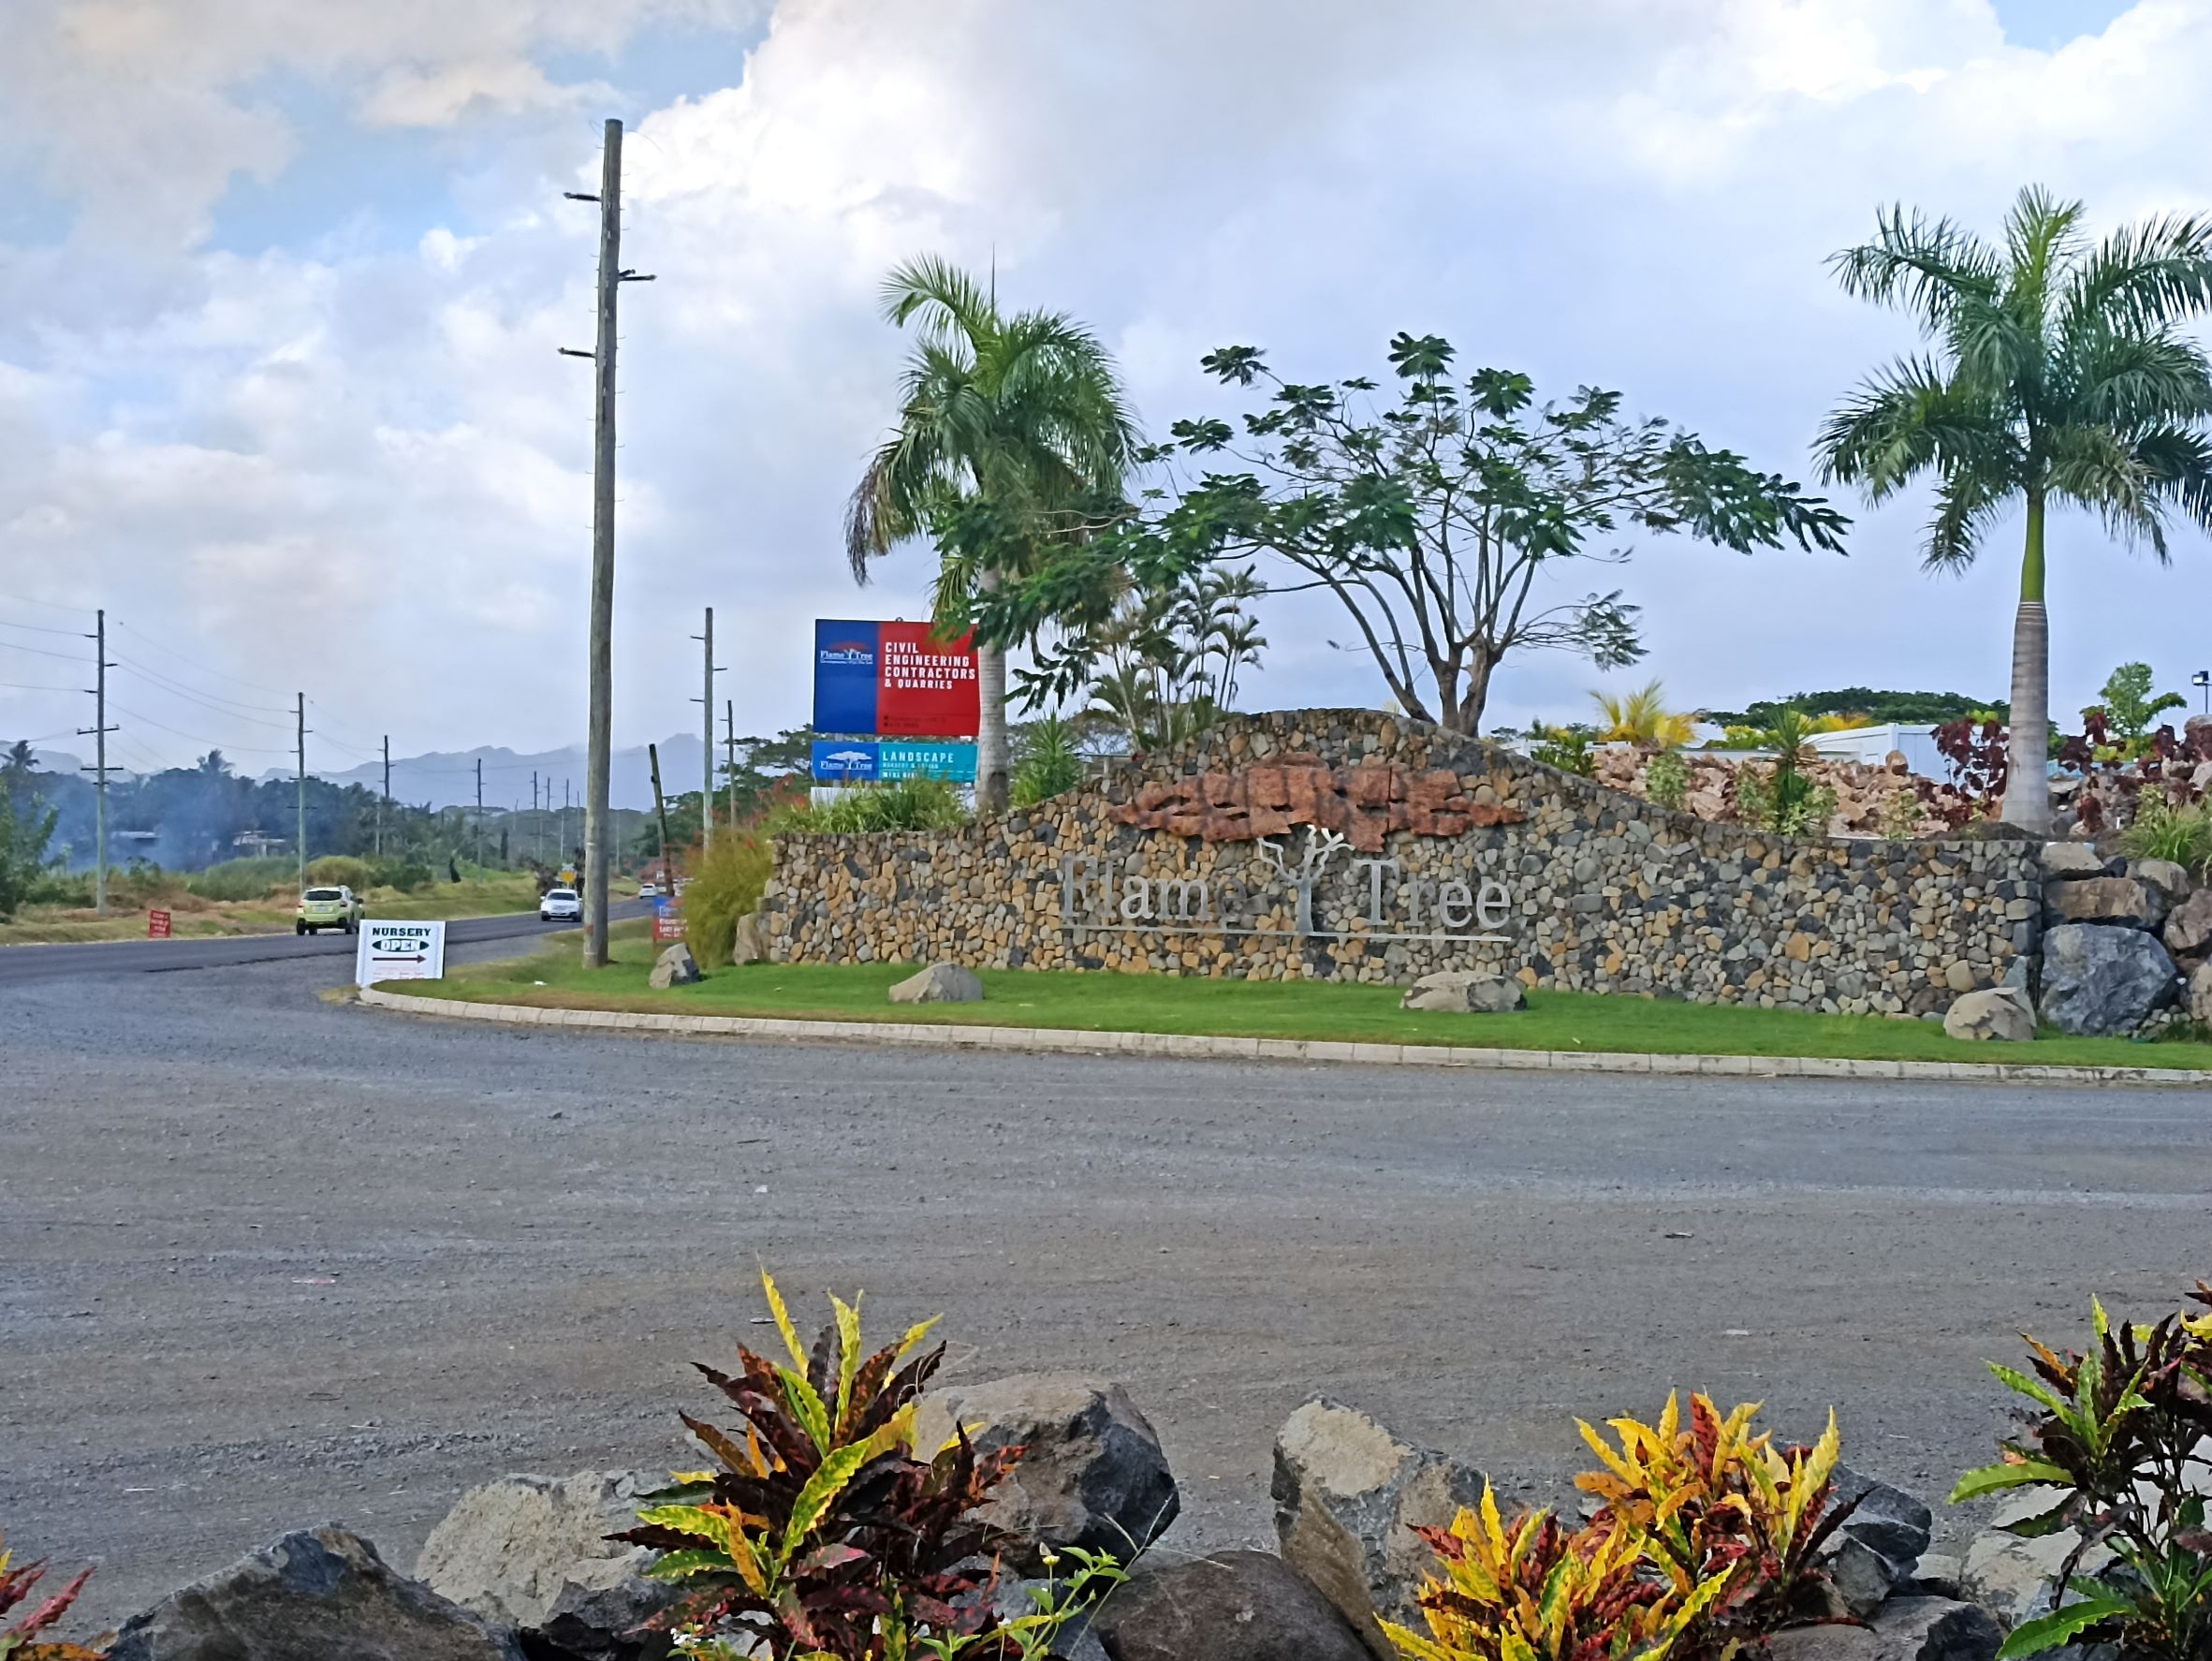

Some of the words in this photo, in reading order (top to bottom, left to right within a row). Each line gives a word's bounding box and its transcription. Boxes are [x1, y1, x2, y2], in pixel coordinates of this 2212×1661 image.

[886, 641, 918, 654] CIVIL
[885, 654, 970, 668] ENGINEERING
[885, 667, 975, 680] CONTRACTORS
[884, 680, 892, 688] &
[898, 680, 953, 690] QUARRIES
[883, 751, 954, 763] LANDSCAPE
[1062, 855, 1250, 922] Flame
[1354, 859, 1512, 929] Tree
[372, 928, 432, 936] NURSERY
[380, 939, 420, 951] OPEN
